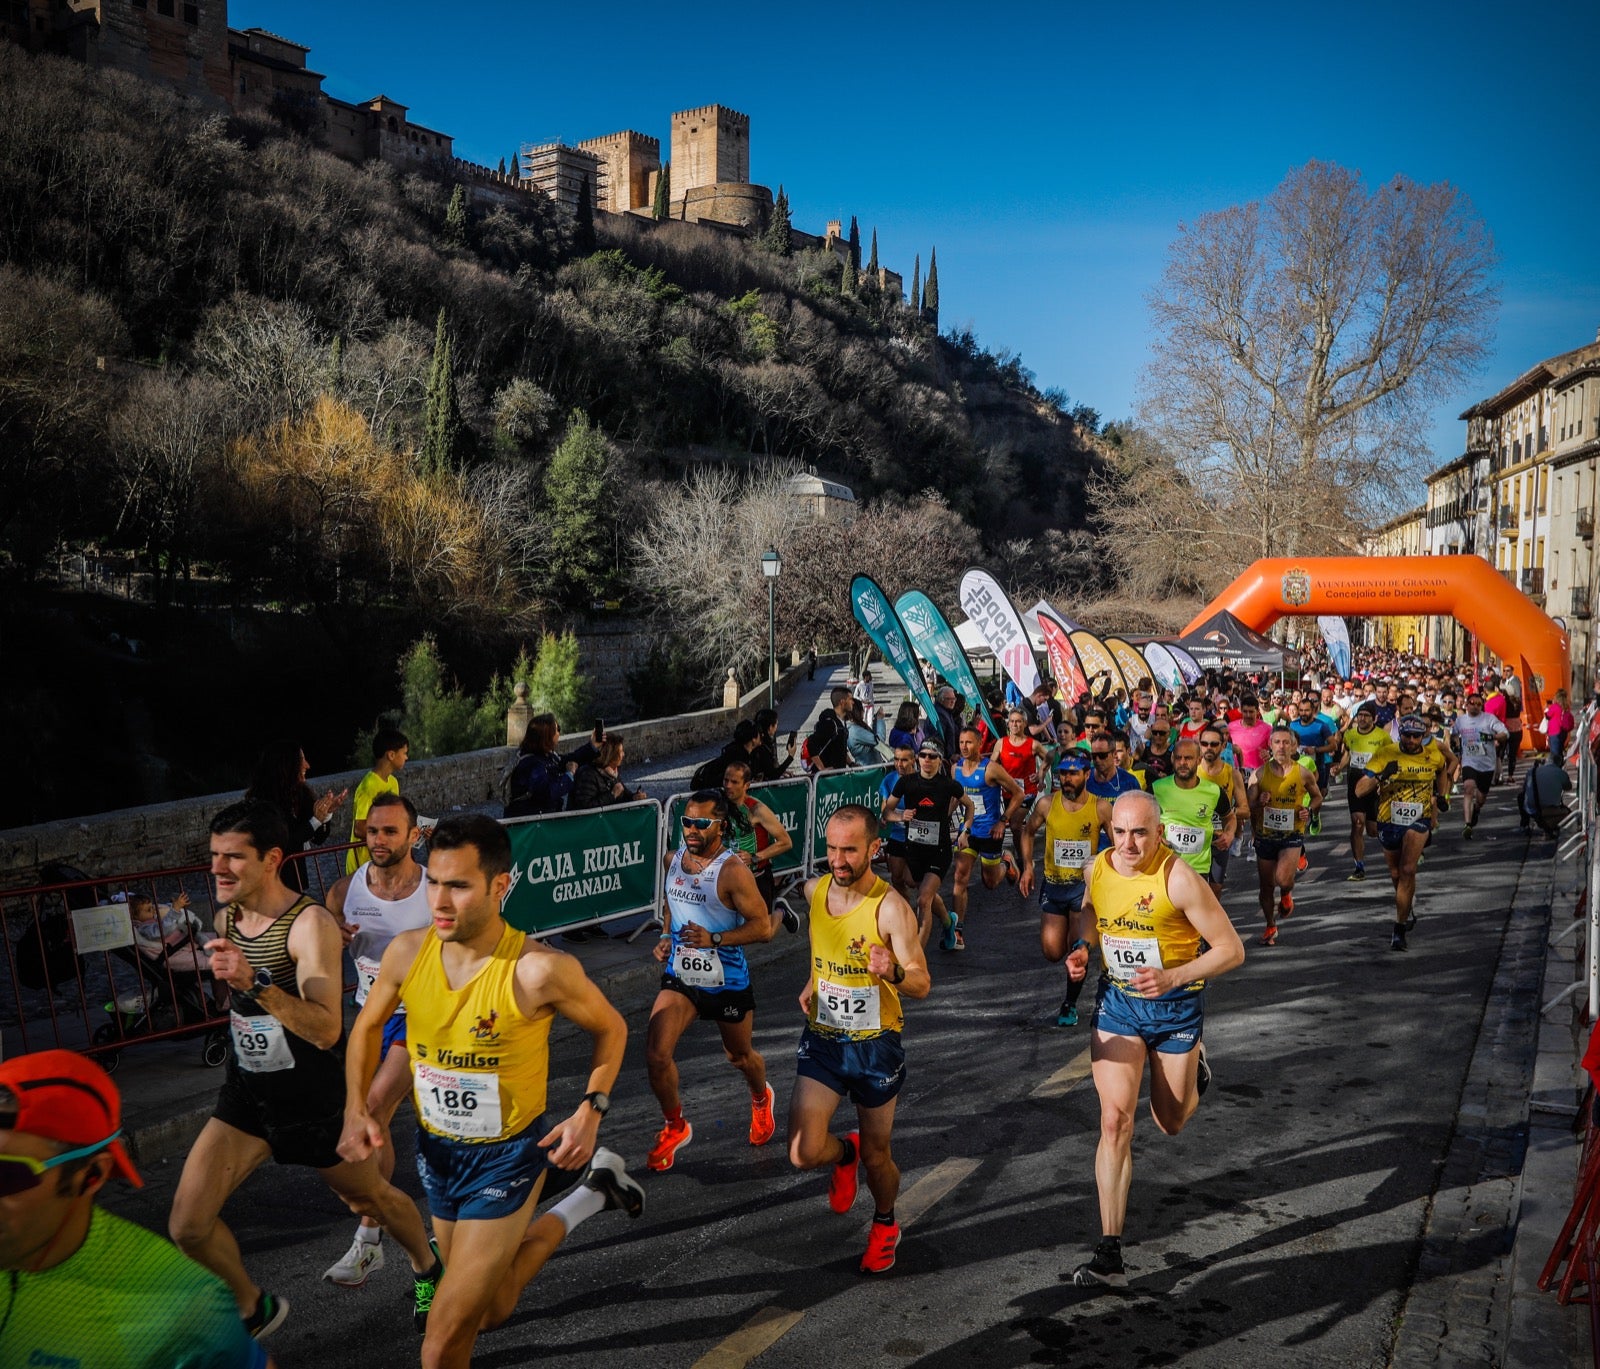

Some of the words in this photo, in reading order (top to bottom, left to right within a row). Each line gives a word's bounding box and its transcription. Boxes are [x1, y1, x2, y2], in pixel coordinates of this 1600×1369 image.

[1388, 580, 1399, 588] DE
[1402, 577, 1448, 587] GRANADA
[1379, 589, 1391, 597] de
[1394, 589, 1437, 598] Deportes
[1269, 813, 1288, 822] 485
[1395, 808, 1417, 818] 420
[917, 827, 929, 835] 80
[1176, 833, 1197, 843] 180
[1062, 848, 1084, 857] 229
[527, 852, 576, 884] CAJA
[582, 840, 645, 874] RURAL
[552, 873, 622, 904] GRANADA
[668, 887, 707, 903] MARACENA
[1113, 917, 1155, 932] Vigilsa
[1113, 949, 1147, 964] 164
[682, 957, 713, 972] 668
[827, 961, 868, 976] Vigilsa
[827, 995, 867, 1014] 512
[437, 1048, 500, 1067] Vigilsa
[431, 1086, 478, 1110] 186
